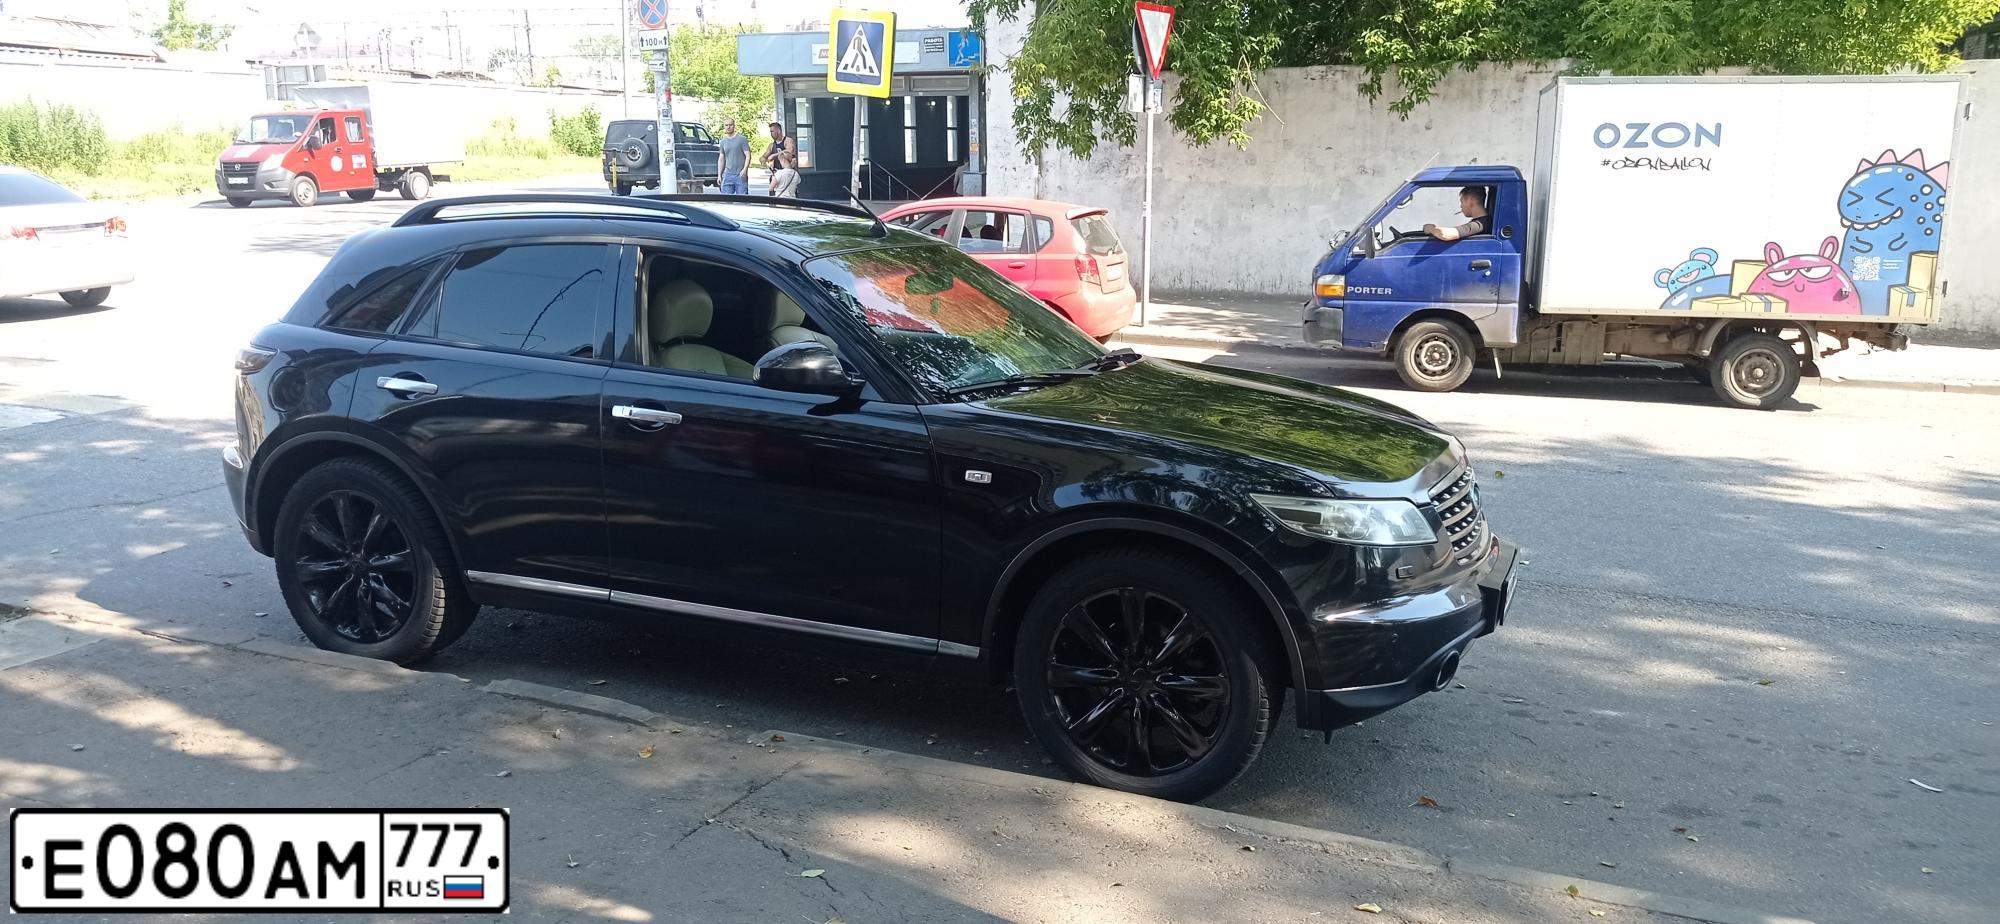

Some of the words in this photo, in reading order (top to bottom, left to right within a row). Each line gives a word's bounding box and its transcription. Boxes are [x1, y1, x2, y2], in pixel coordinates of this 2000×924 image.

[1593, 122, 1722, 149] OZON
[1601, 156, 1712, 171] #OZONBALLON
[1347, 286, 1392, 295] PORTER
